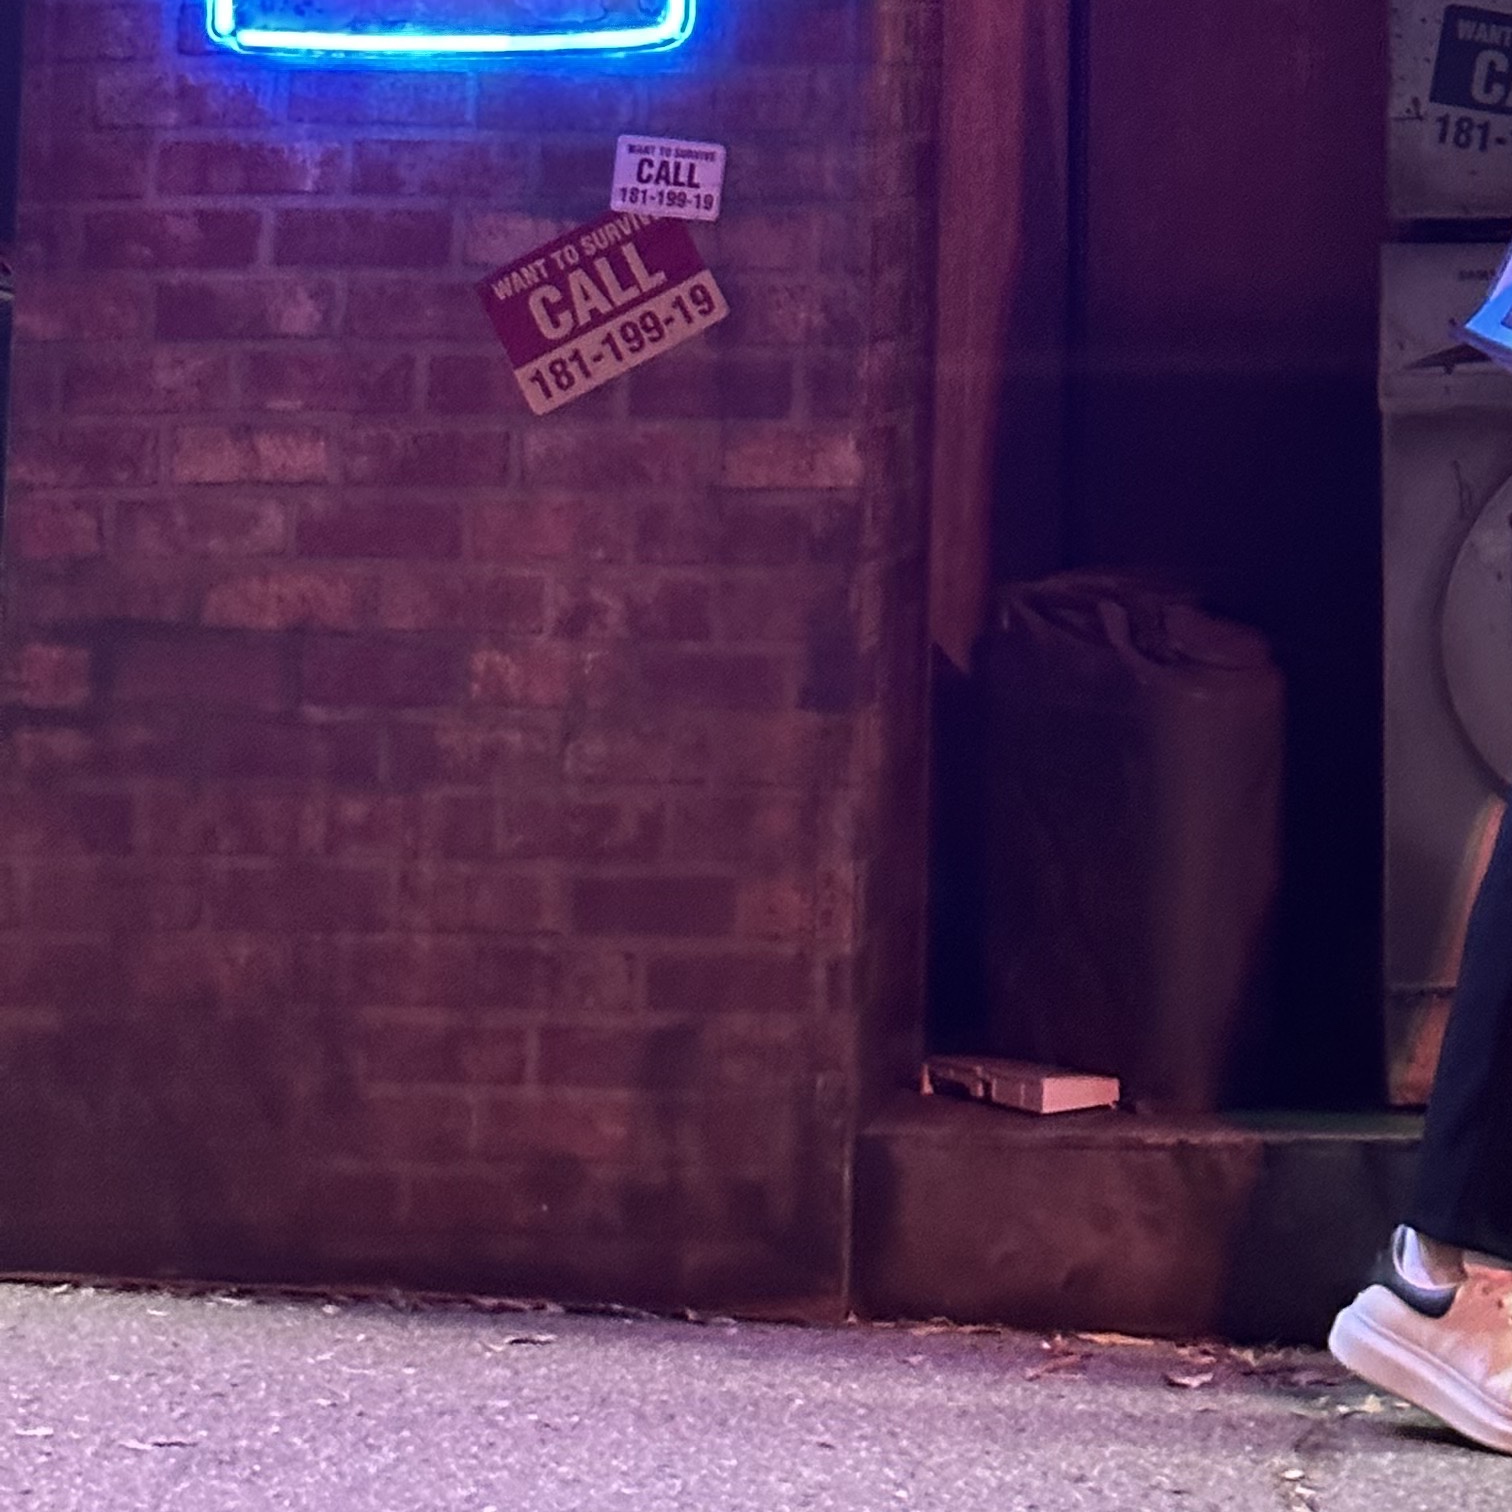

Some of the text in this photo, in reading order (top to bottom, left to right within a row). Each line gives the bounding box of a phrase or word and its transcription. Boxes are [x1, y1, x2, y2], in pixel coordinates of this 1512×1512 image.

[1457, 18, 1512, 48] WANT
[636, 157, 700, 188] CALL
[620, 186, 714, 211] 181-199-19
[492, 258, 549, 300] WANT
[550, 243, 580, 270] TO
[528, 241, 668, 340] CALL
[529, 283, 716, 400] 181-199-19
